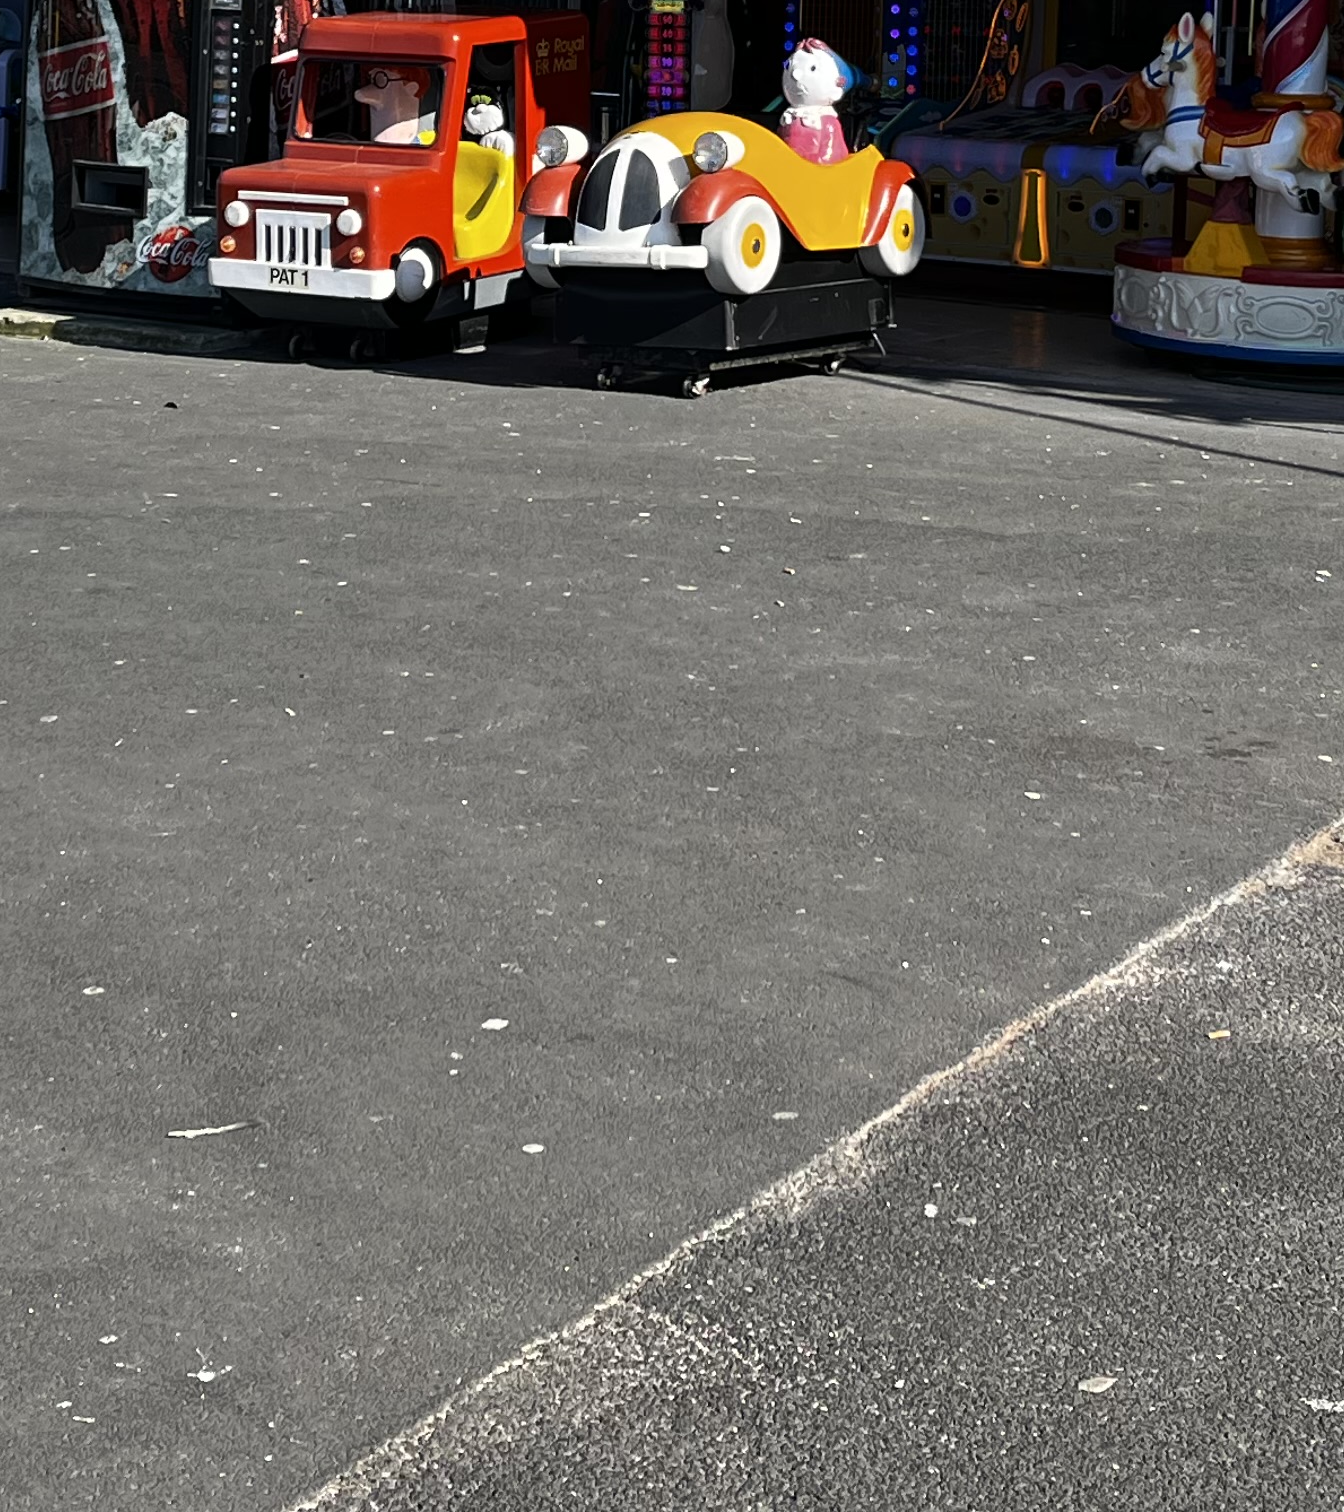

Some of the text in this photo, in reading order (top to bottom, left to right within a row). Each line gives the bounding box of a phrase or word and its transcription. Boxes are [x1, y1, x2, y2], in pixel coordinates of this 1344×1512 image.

[553, 35, 585, 56] Royal
[552, 53, 578, 74] Mail
[269, 267, 309, 287] PAT 1
